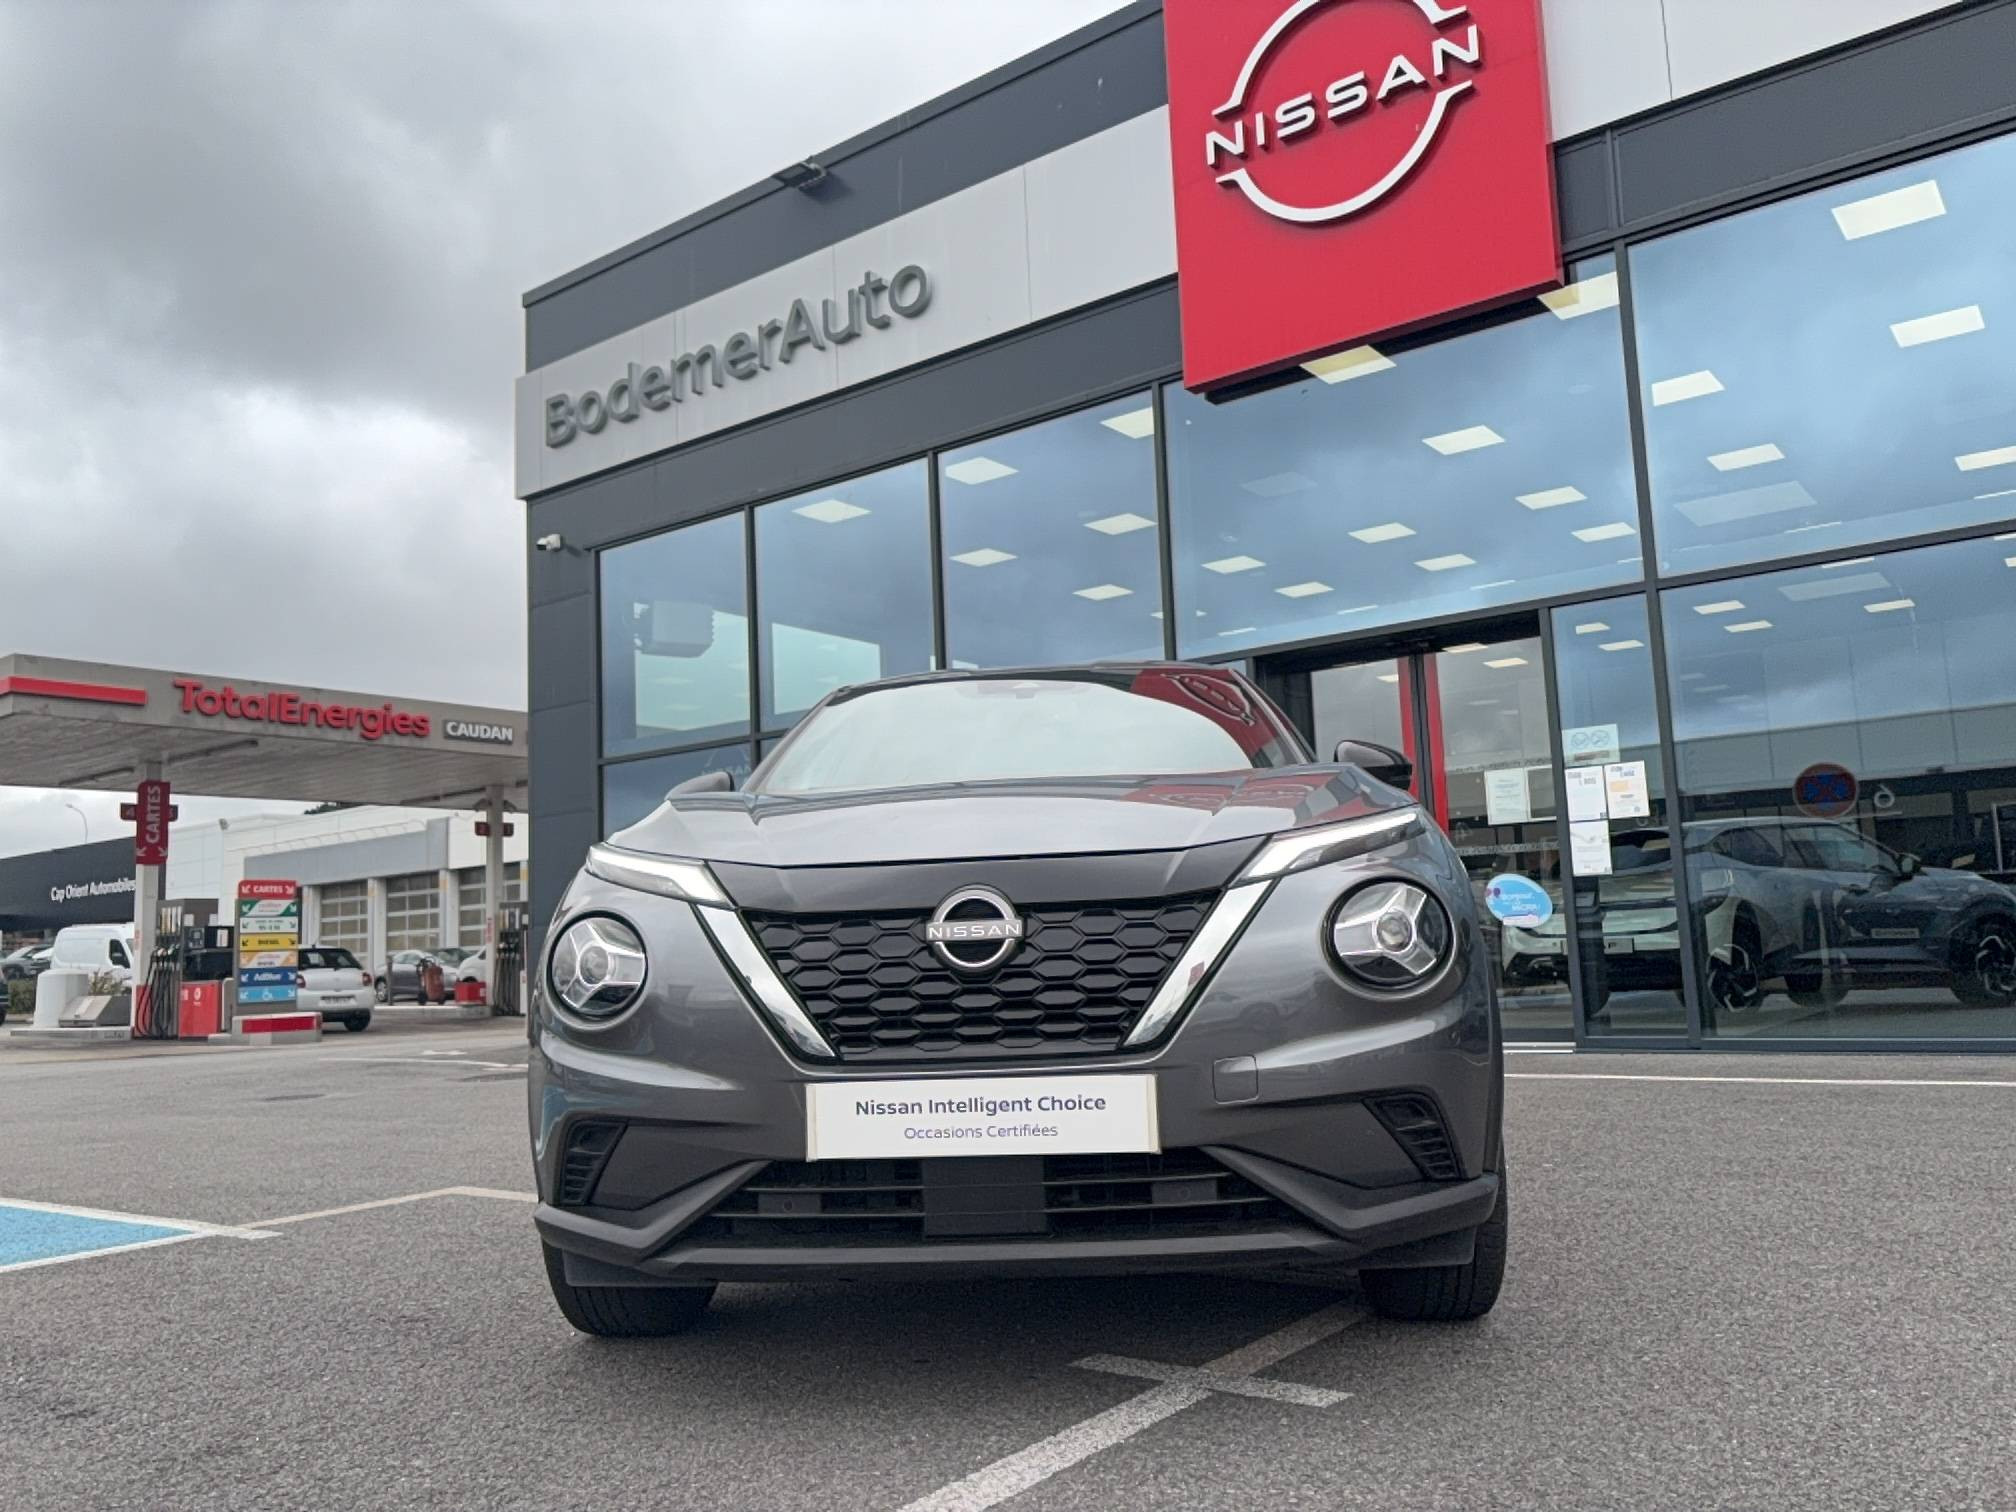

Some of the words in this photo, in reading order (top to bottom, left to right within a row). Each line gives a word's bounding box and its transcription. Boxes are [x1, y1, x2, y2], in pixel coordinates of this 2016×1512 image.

[1205, 24, 1482, 168] NISSAN
[545, 264, 932, 449] BodemerAuto
[174, 678, 431, 739] TotalEnergies
[446, 720, 513, 742] CAUDAN
[145, 784, 161, 844] CARTES
[50, 886, 65, 902] Cap
[252, 883, 283, 893] CARTES
[928, 923, 1020, 939] NISSAN
[855, 1099, 923, 1116] Nissan
[928, 1096, 1033, 1117] Intelligent
[1037, 1094, 1107, 1112] Choice
[903, 1126, 983, 1140] Occasions
[986, 1124, 1059, 1138] Certifiées
